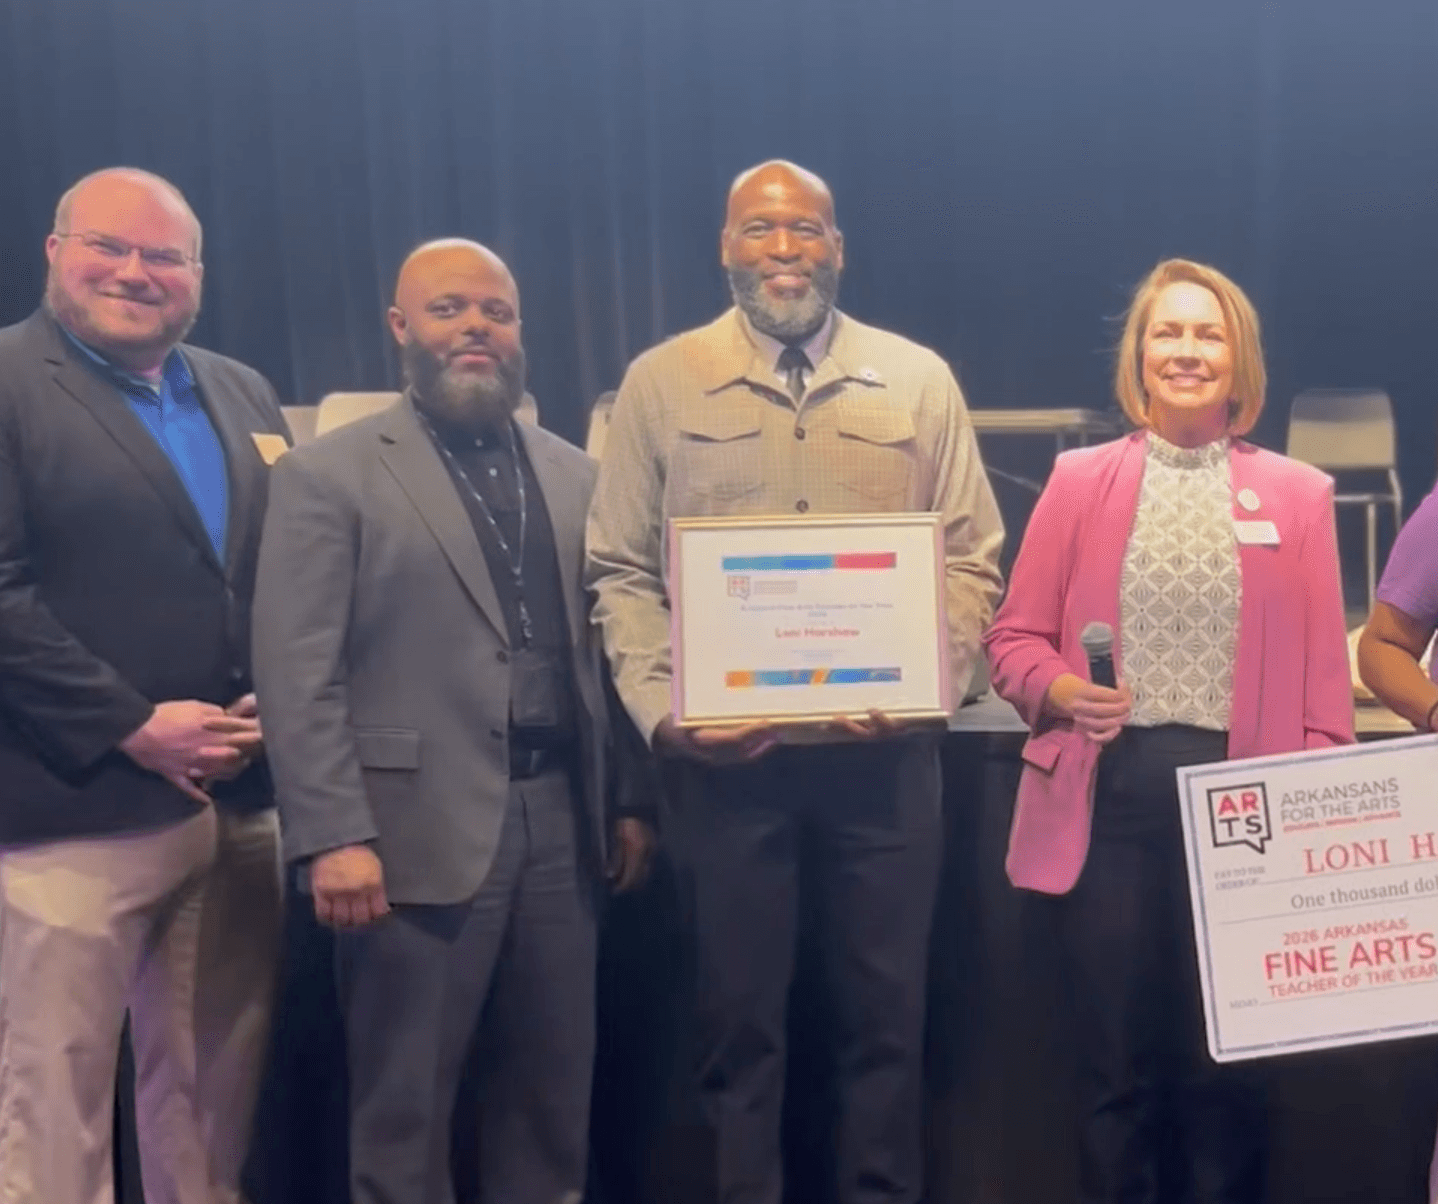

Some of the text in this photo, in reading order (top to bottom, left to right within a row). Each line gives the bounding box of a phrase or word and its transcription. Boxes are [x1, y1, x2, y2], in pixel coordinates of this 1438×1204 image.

[1217, 791, 1259, 816] AR
[1280, 777, 1400, 807] ARKANSANS
[1281, 806, 1316, 823] FOR
[1320, 800, 1354, 817] THE
[1357, 795, 1401, 813] ARTS
[1218, 815, 1264, 837] TS
[1304, 838, 1391, 875] LONI
[1291, 894, 1326, 909] One
[1330, 881, 1410, 904] thousand
[1283, 918, 1410, 946] 2026 ARKANSAS
[1265, 933, 1438, 980] FINE ARTS
[1269, 972, 1339, 997] TEACHER
[1342, 972, 1362, 989] OF
[1367, 968, 1395, 985] THE
